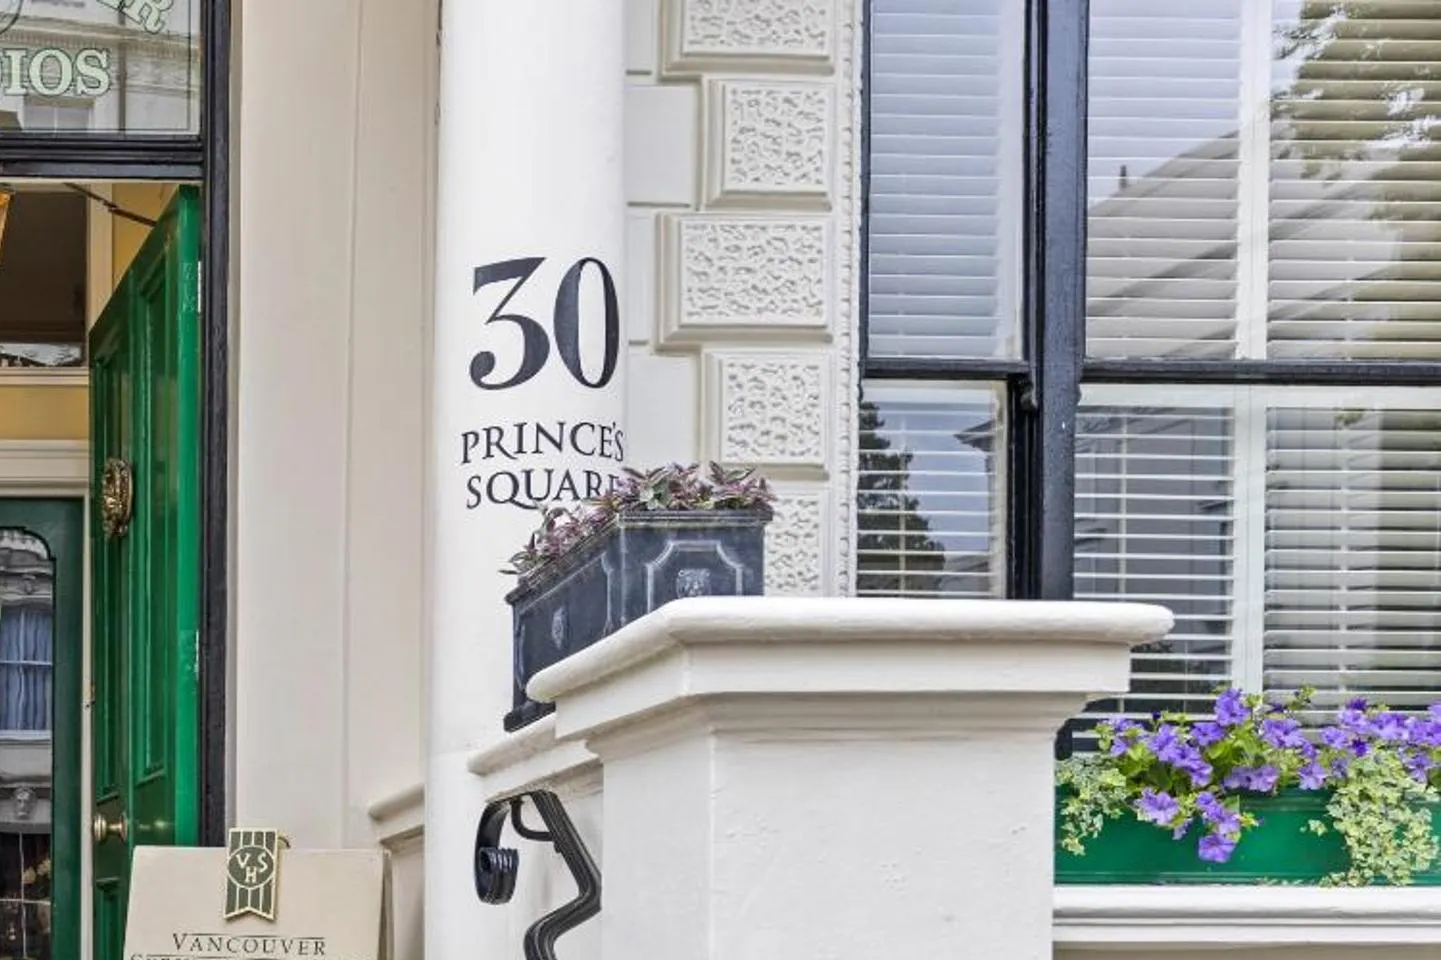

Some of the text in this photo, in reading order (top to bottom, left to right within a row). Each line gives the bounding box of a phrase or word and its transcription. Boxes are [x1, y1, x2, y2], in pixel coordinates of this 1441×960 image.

[469, 256, 619, 390] 30
[460, 421, 625, 464] PRINCE'S
[172, 932, 327, 956] VANCOUVER
